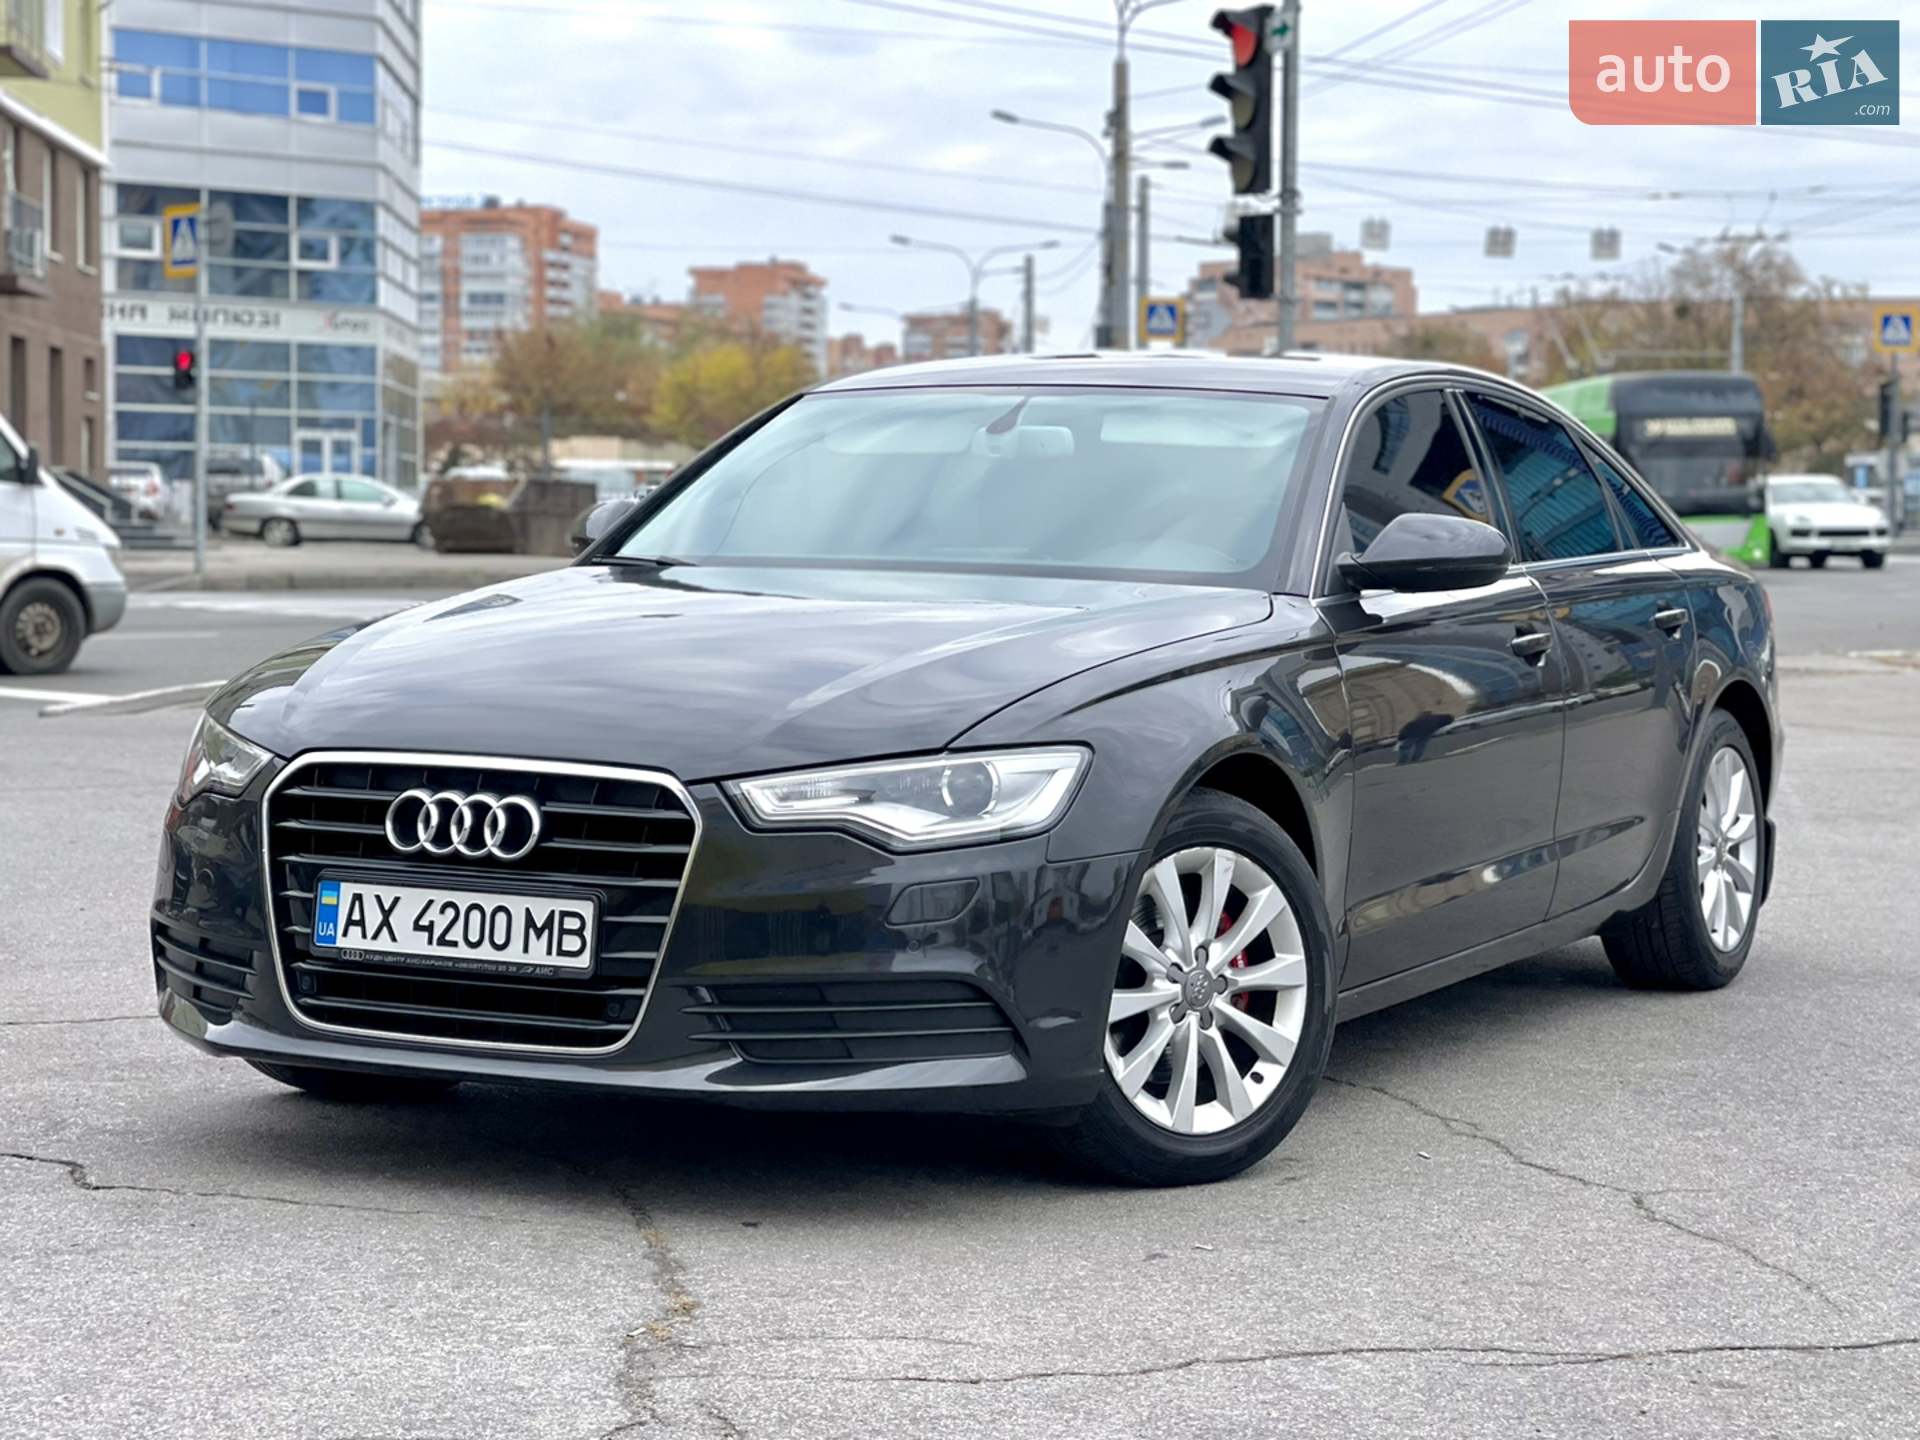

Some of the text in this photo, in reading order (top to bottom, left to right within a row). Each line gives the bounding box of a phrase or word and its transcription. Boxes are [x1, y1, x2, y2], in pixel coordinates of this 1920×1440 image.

[318, 921, 335, 937] UA
[341, 892, 587, 958] AX 4200 MB
